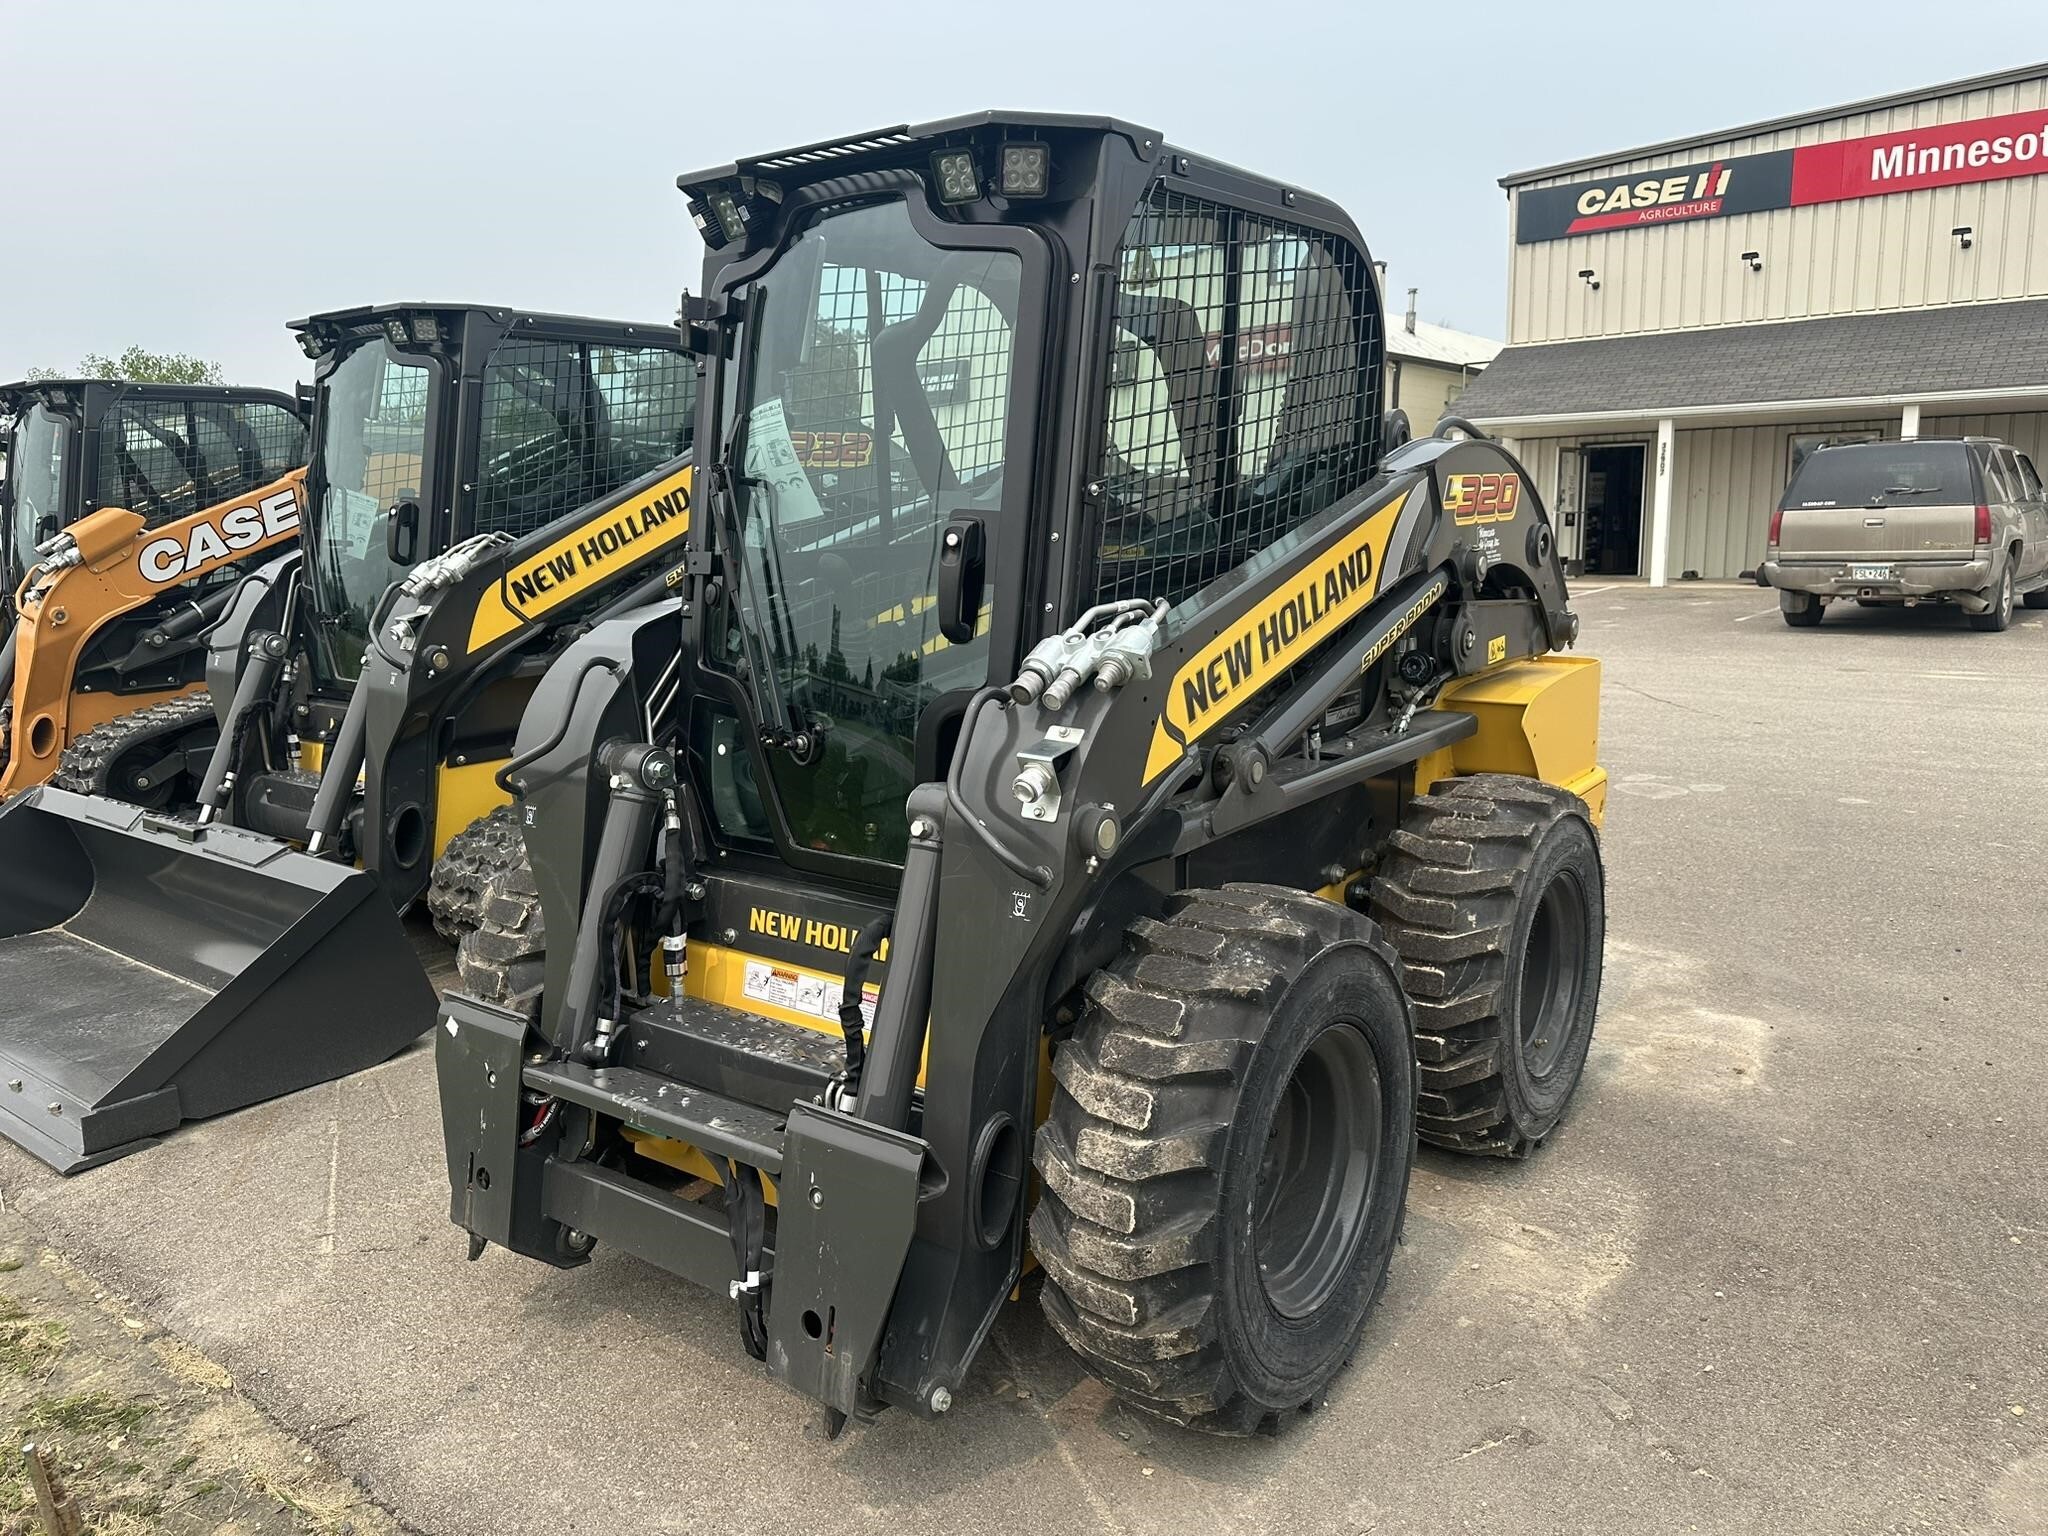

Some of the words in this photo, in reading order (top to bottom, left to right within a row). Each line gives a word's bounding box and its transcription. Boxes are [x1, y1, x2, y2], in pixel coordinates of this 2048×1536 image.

[1577, 175, 1690, 215] CASE
[1638, 201, 1717, 221] AGRICULTURE
[138, 488, 301, 583] CASE
[510, 550, 576, 605] NEW
[577, 486, 691, 567] HOLLAND
[1182, 631, 1252, 724] NEW
[1257, 542, 1373, 665] HOLLAND
[1361, 618, 1406, 673] SUPER
[1406, 582, 1441, 628] BOOM
[749, 907, 802, 941] NEW
